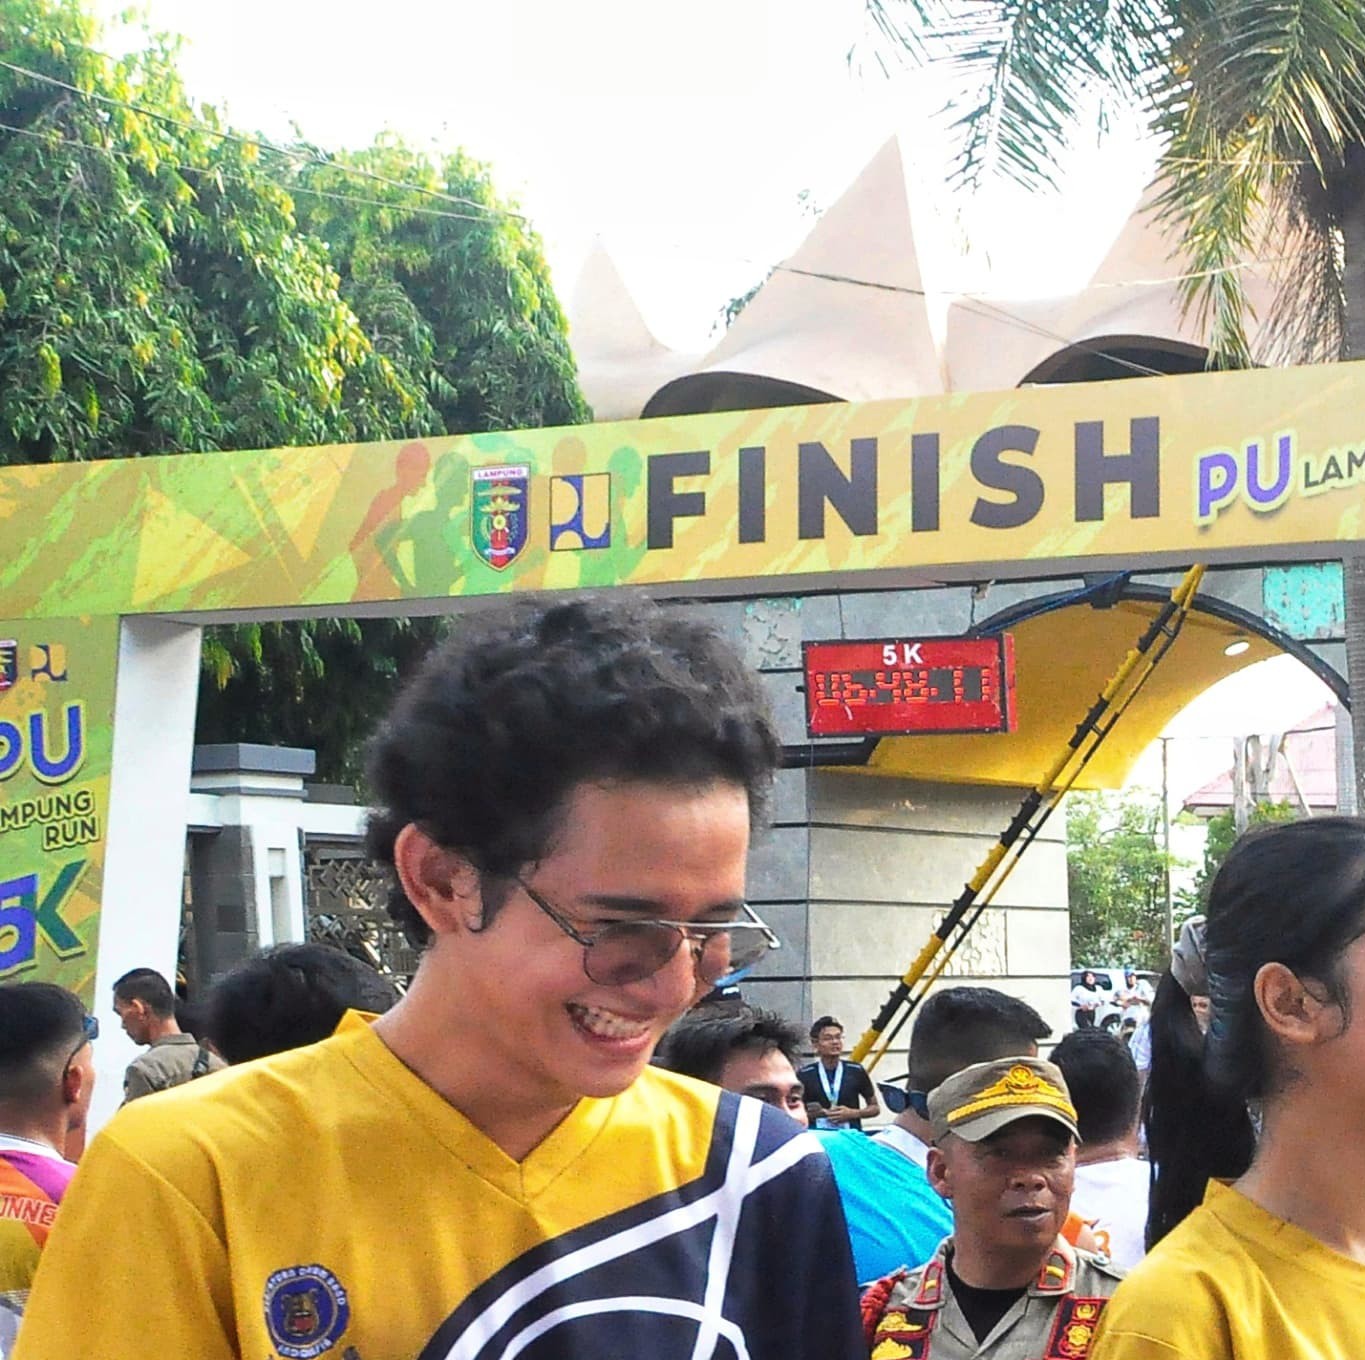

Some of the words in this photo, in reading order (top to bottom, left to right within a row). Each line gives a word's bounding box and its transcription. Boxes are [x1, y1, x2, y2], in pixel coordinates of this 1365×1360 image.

[648, 416, 1160, 550] FINISH
[1200, 436, 1291, 518] PU
[0, 791, 91, 827] MPUNG
[46, 817, 97, 848] RUN
[0, 859, 87, 971] 5K
[0, 1196, 58, 1227] NNE
